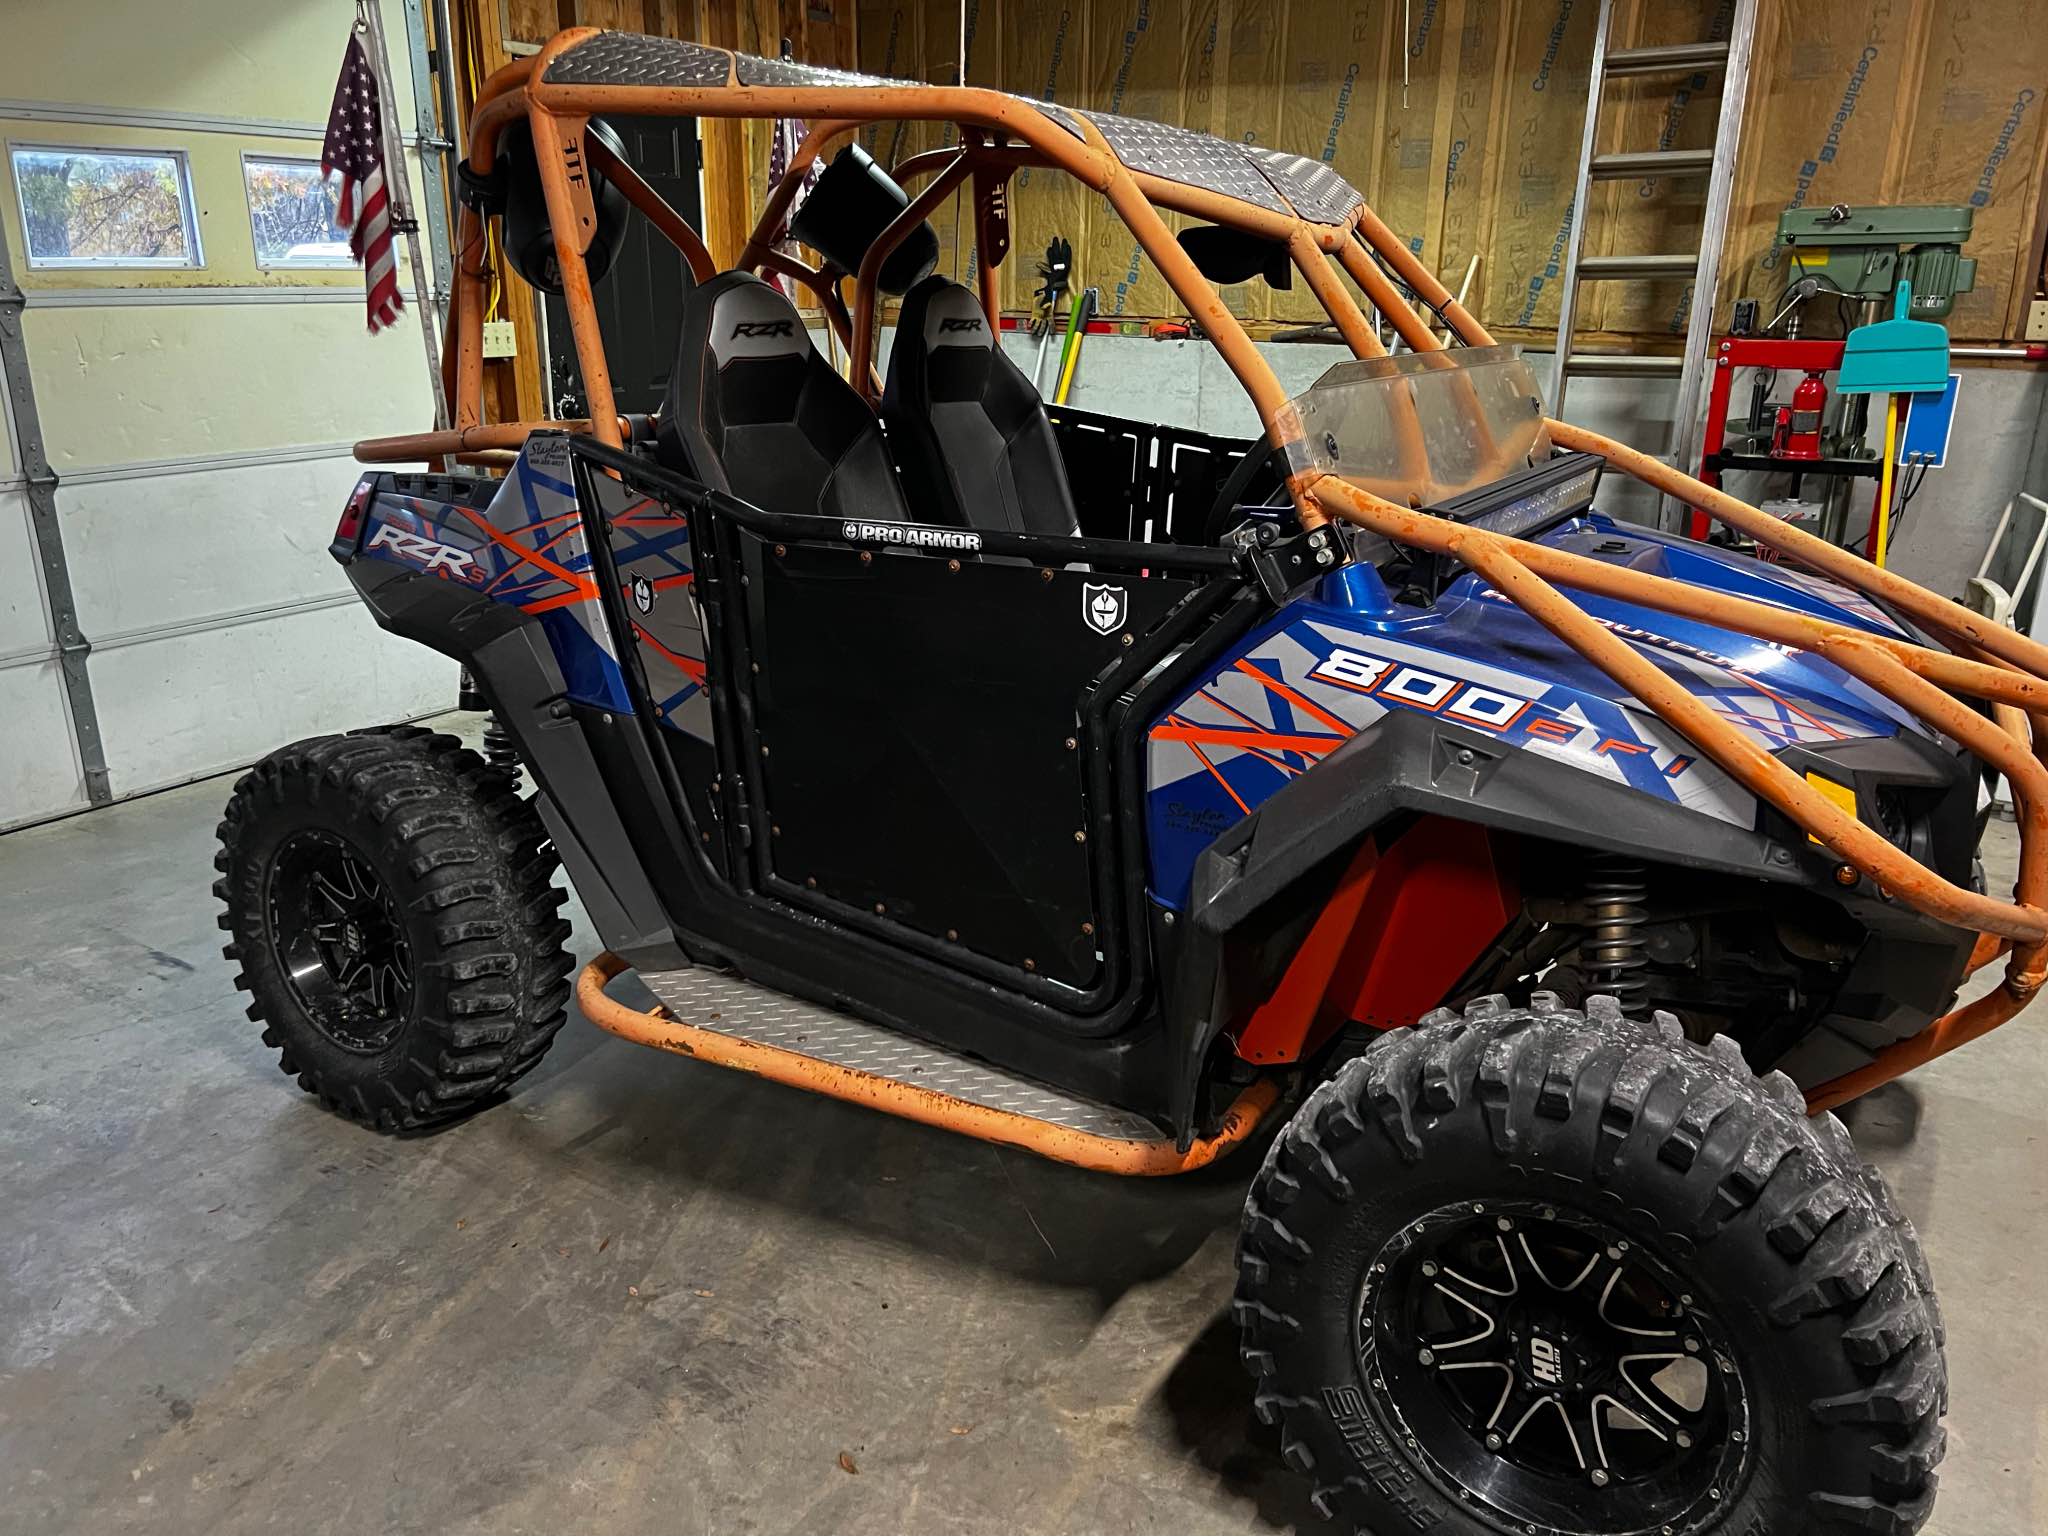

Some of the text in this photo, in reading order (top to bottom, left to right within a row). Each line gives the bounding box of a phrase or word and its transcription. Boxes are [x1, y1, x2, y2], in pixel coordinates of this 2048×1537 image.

[1112, 45, 1134, 114] ertainTeed
[1326, 63, 1360, 149] CertainTeed
[1827, 47, 1878, 145] CertainTeed
[1979, 89, 2034, 189] CertainTeed
[731, 320, 794, 341] RZR
[938, 319, 982, 334] RZR
[367, 523, 476, 579] RZR
[861, 525, 981, 551] PRO ARMOR
[1313, 648, 1692, 775] 800 EFI
[1531, 1337, 1557, 1384] HD
